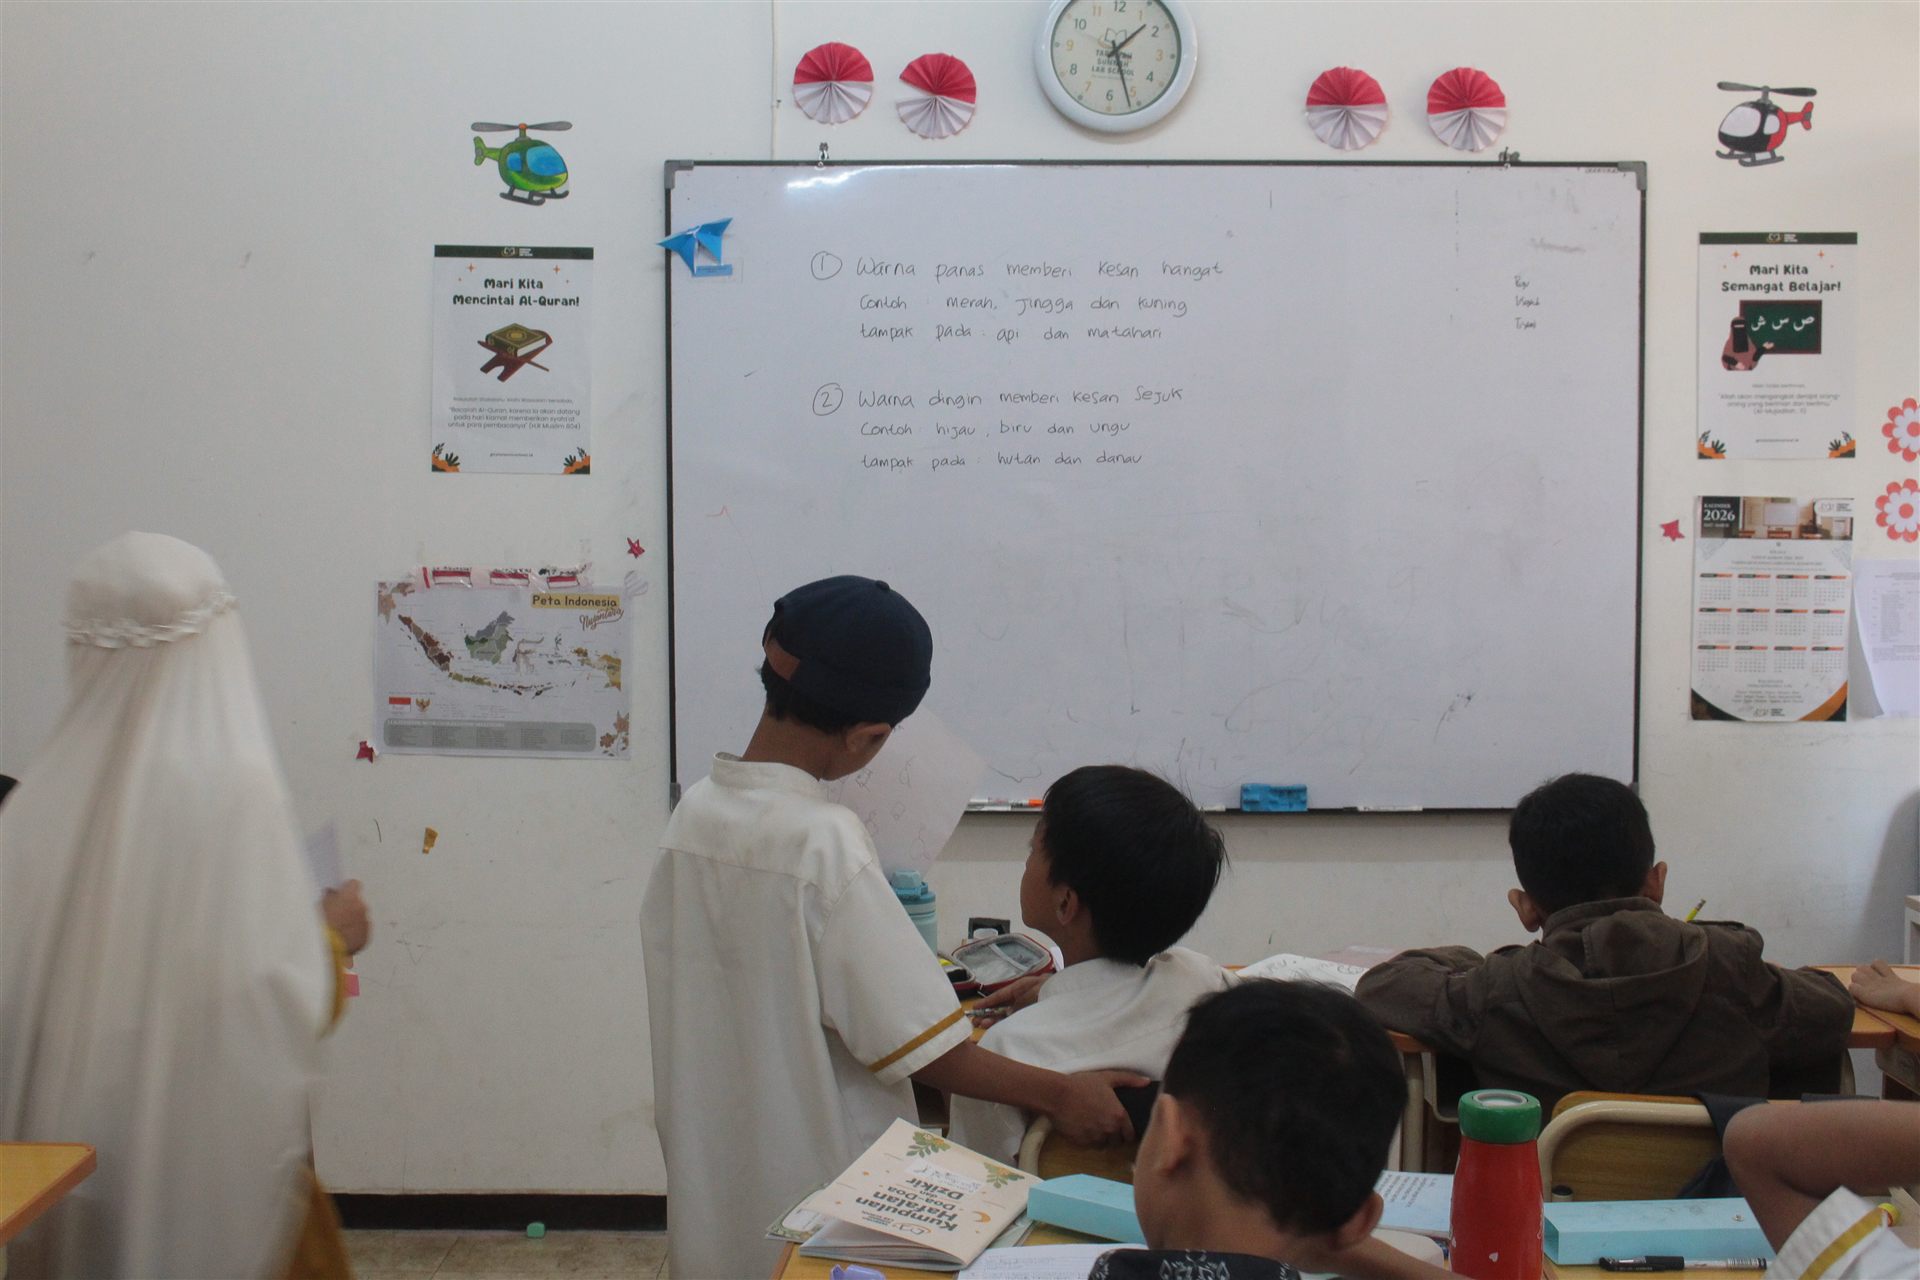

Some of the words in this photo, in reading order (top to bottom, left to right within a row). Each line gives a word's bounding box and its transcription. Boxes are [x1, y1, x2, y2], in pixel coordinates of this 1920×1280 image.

[1092, 6, 1102, 16] 11
[1113, 0, 1126, 12] 12
[1074, 19, 1087, 30] 10
[1151, 26, 1159, 38] 2
[1066, 40, 1073, 51] 9
[1156, 50, 1164, 62] 3
[1069, 64, 1077, 75] 8
[1146, 71, 1154, 82] 4
[1084, 81, 1092, 91] 7
[1130, 86, 1137, 97] 5
[1106, 90, 1113, 101] 6
[856, 256, 916, 277] Warna
[935, 263, 985, 285] panas
[1006, 260, 1073, 278] memberi
[1161, 259, 1224, 282] hangat
[1749, 265, 1779, 275] Mari
[1783, 265, 1809, 275] Kita
[484, 278, 514, 289] Mari
[518, 278, 543, 290] Kita
[1721, 281, 1784, 294] Semangat
[1789, 281, 1841, 294] Belajar!
[453, 294, 514, 306] Mencintai
[519, 295, 580, 307] Al-Quran!
[860, 294, 907, 310] Contoh
[1090, 298, 1120, 310] dan
[1138, 295, 1188, 318] kuning
[860, 323, 914, 342] tampak
[997, 328, 1020, 345] api
[1043, 327, 1069, 341] dan
[1087, 325, 1162, 339] matahari
[858, 390, 915, 408] Warna
[928, 389, 983, 409] dingin
[1000, 390, 1060, 405] memberi
[860, 421, 913, 436] Contoh
[999, 419, 1033, 434] biru
[1047, 422, 1075, 435] dan
[1089, 421, 1131, 438] ungu
[861, 454, 914, 471] tampak
[932, 454, 966, 471] pada
[998, 451, 1041, 465] hutan
[1055, 451, 1082, 465] dan
[1095, 450, 1143, 465] danau
[1703, 509, 1736, 521] 2026
[532, 594, 561, 606] Peta
[564, 595, 617, 607] Indonesia
[905, 1178, 964, 1200] Dzikir
[920, 1190, 938, 1198] dan
[887, 1186, 956, 1211] Doa-Doa
[873, 1191, 958, 1221] Hafalan
[855, 1197, 958, 1231] Kumpulan
